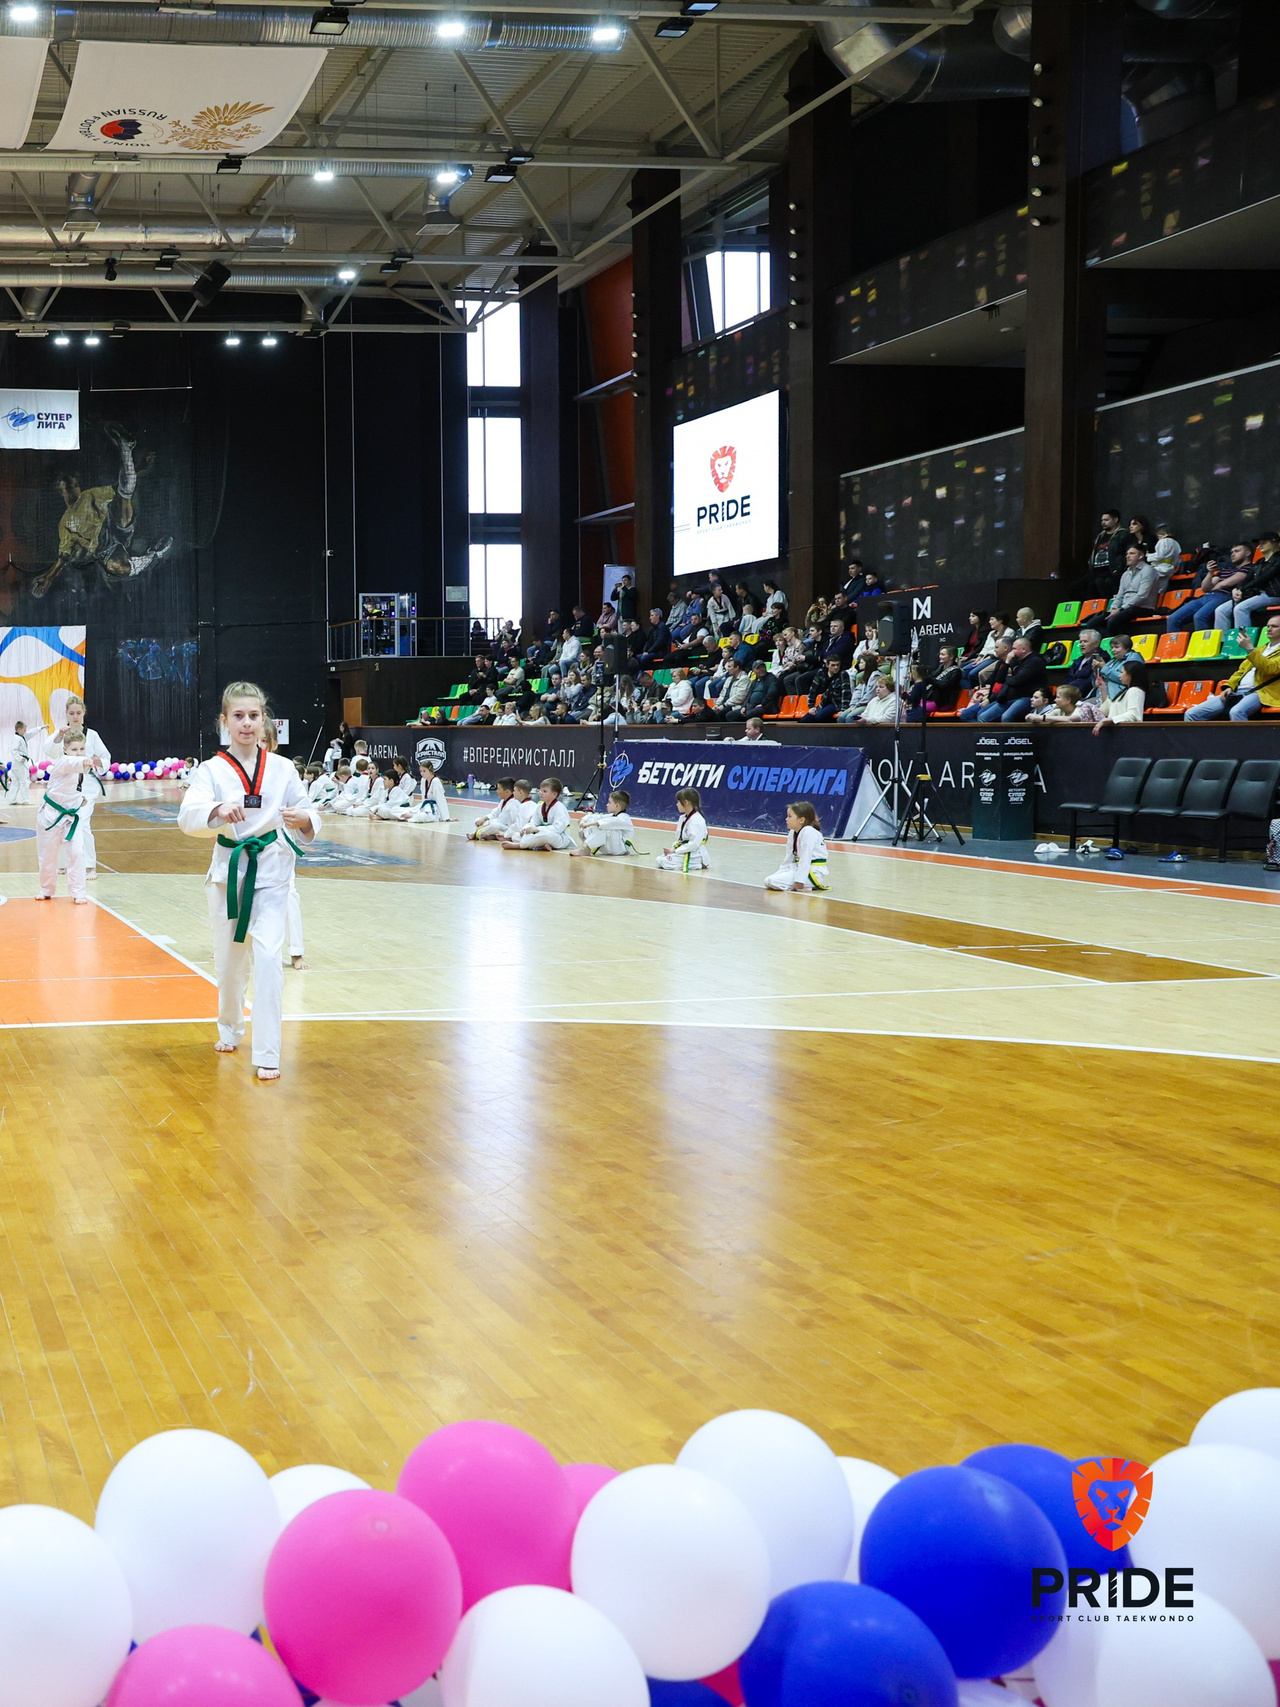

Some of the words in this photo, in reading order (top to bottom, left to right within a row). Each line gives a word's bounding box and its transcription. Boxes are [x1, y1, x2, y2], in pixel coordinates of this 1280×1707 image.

[100, 108, 168, 121] RUSSIAN
[36, 412, 72, 421] СУПЕР
[36, 421, 66, 430] ЛИГА
[697, 494, 751, 527] PRIDE
[918, 622, 954, 636] ARENA
[976, 737, 1000, 745] JÖGEL
[1004, 737, 1033, 745] JÖGEL
[462, 748, 576, 768] #ВПЕРЕДКРИСТАЛЛ
[637, 761, 726, 789] БЕТСИТИ
[727, 765, 848, 796] СУПЕРЛИГА
[938, 761, 1047, 793] ARA
